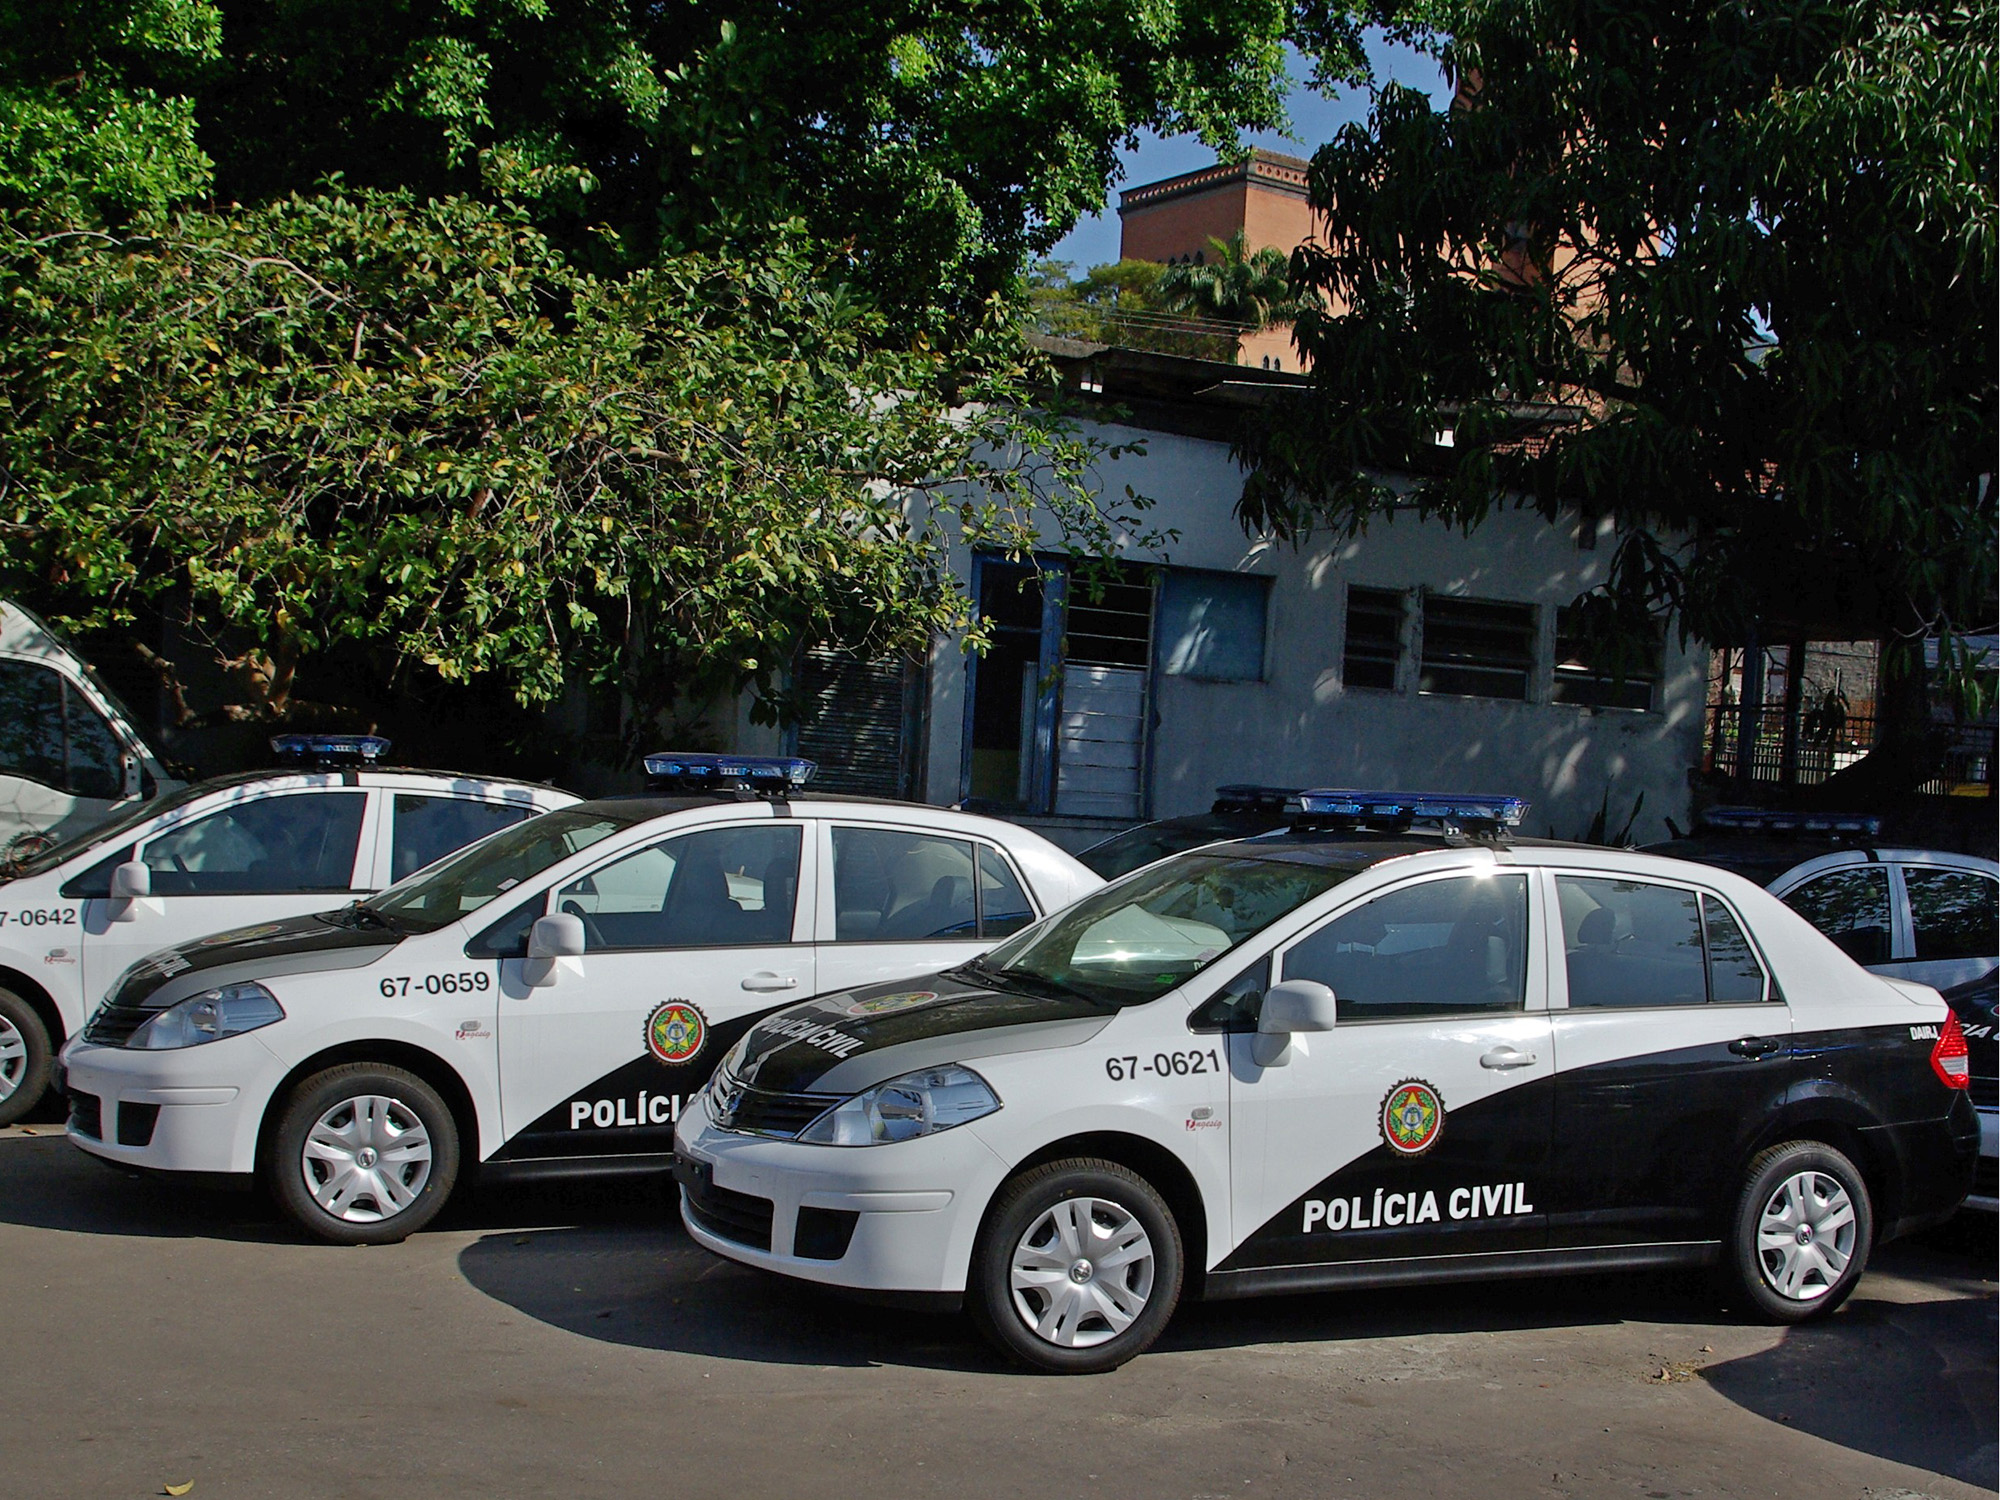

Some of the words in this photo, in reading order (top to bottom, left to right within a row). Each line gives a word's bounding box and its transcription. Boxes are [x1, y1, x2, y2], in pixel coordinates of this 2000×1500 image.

[380, 971, 489, 998] 67-0659
[806, 1028, 865, 1059] CIVIL
[1105, 1049, 1220, 1081] 67-0621
[570, 1090, 696, 1130] POLÍCI
[1302, 1188, 1440, 1234] POLÍCIA
[1448, 1182, 1534, 1220] CIVIL
